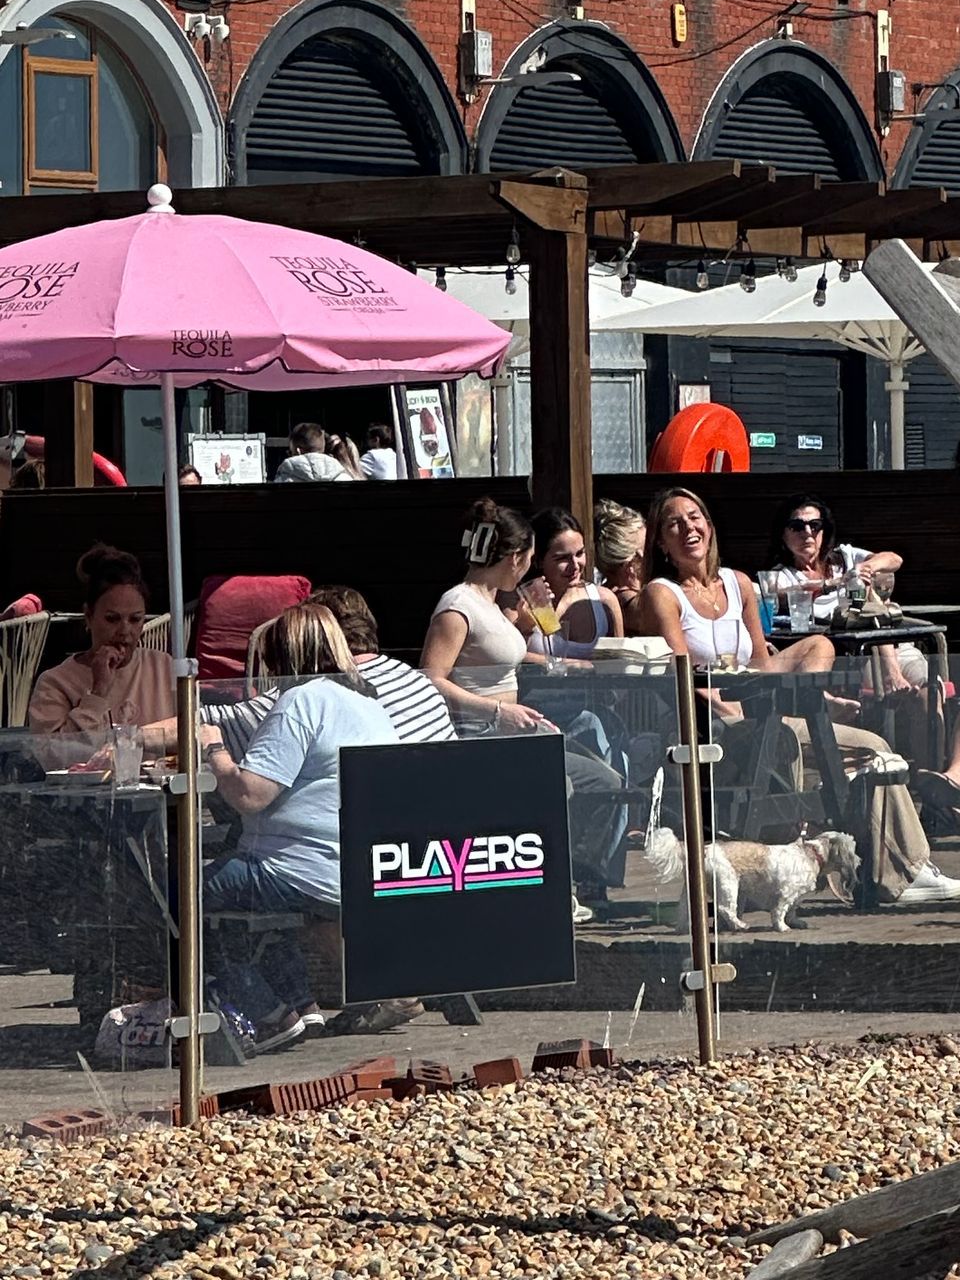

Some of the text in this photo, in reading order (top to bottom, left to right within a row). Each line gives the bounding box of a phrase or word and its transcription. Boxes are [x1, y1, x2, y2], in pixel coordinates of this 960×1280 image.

[269, 256, 359, 271] TEQUILA
[0, 273, 75, 303] OSE
[287, 270, 388, 297] ROSE
[171, 329, 232, 341] TEQUILA
[172, 340, 235, 358] ROSE
[372, 833, 545, 891] PLAYERS
